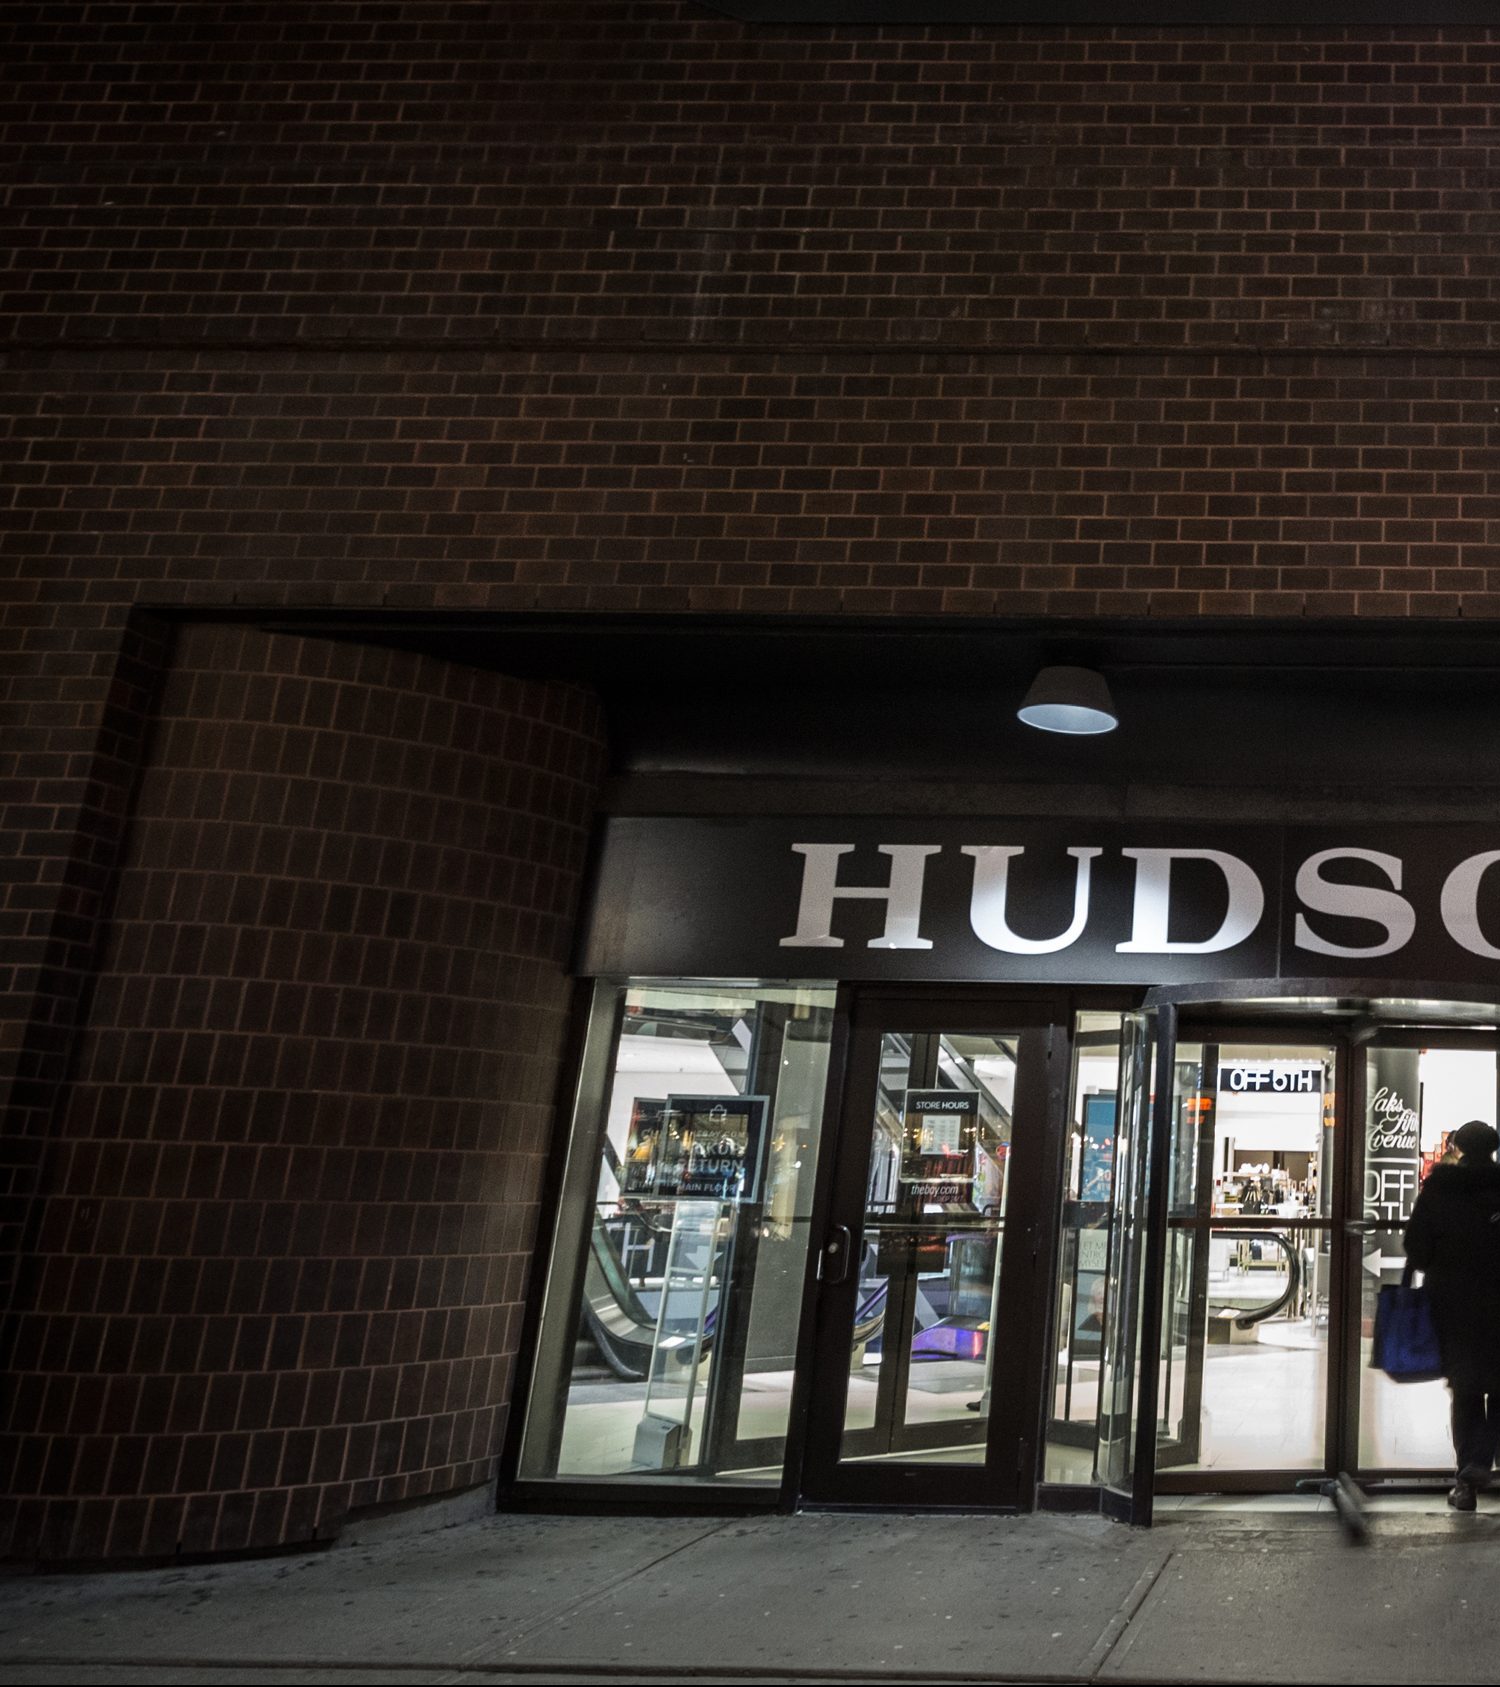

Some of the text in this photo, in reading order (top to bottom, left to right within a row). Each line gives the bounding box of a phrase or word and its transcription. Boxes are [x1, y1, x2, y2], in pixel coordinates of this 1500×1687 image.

[1229, 1068, 1270, 1090] OFF
[916, 1101, 970, 1109] STORE HOURS
[911, 1184, 959, 1197] thebay.com
